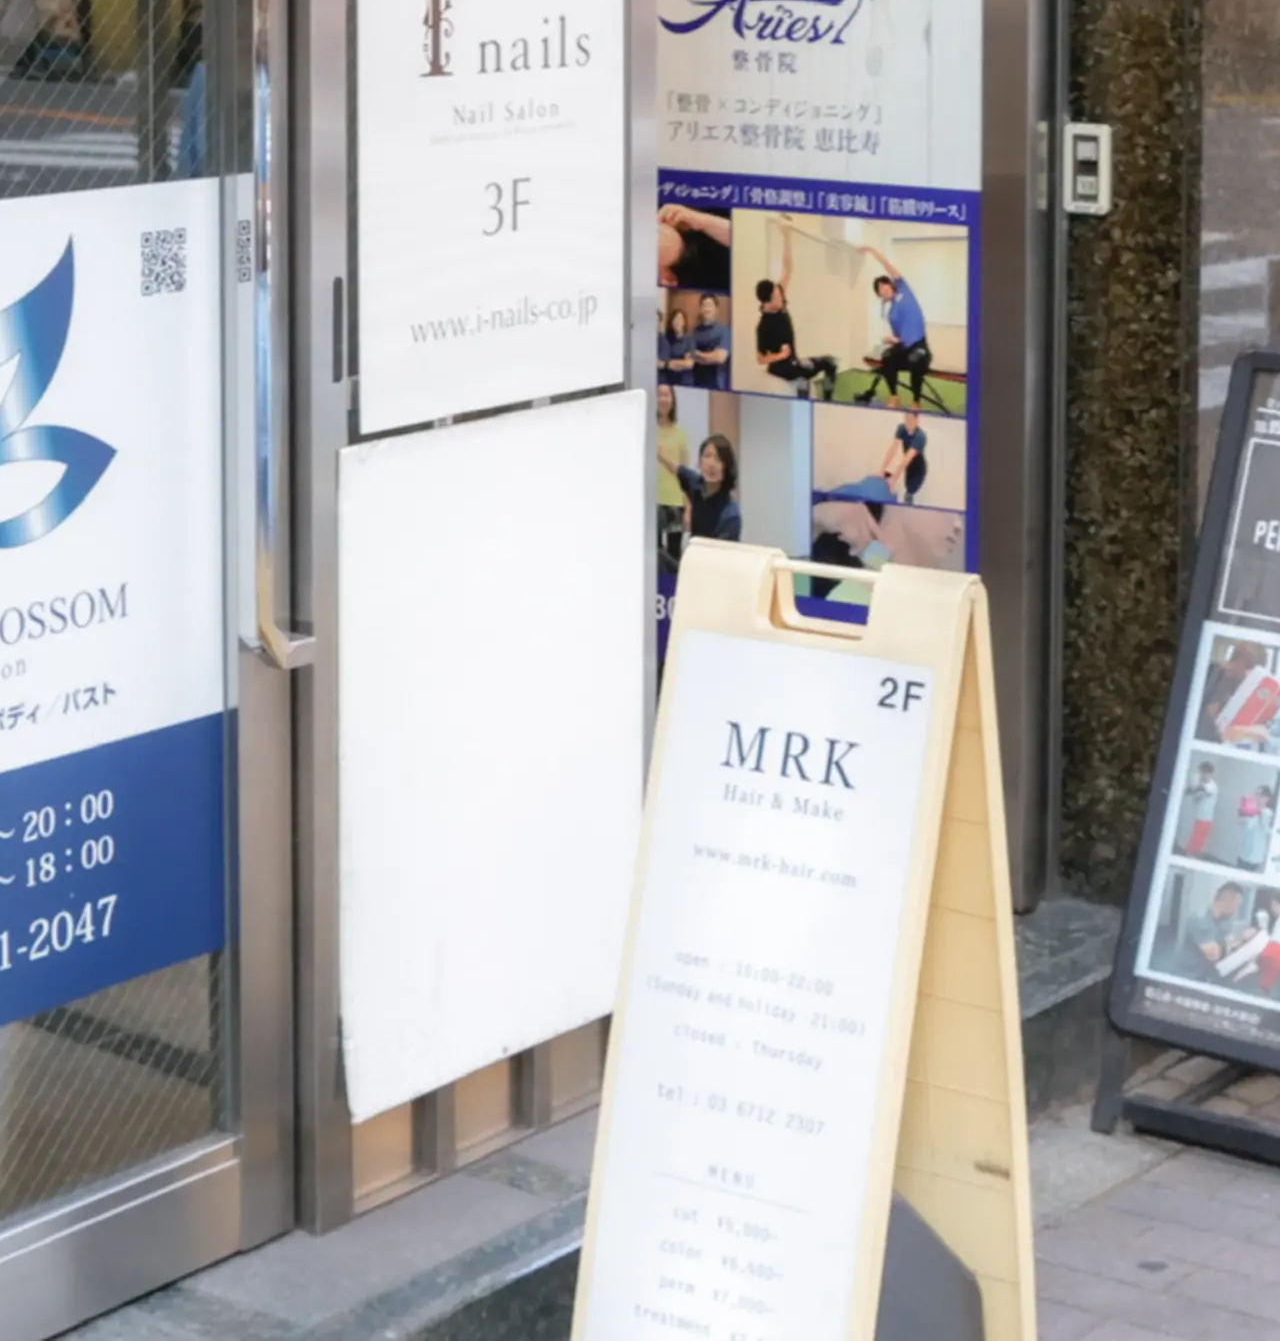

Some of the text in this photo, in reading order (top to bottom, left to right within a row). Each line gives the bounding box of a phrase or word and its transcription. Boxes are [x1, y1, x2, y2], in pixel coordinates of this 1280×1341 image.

[477, 15, 592, 75] nails
[732, 48, 798, 75] 整骨院
[452, 97, 561, 127] Nail Salon
[667, 119, 882, 156] アリエス整骨院 恵比寿
[481, 176, 532, 237] 3F
[876, 676, 927, 713] 2F
[719, 720, 862, 791] MRK
[721, 782, 845, 823] Hair & Make
[692, 842, 859, 890] www.mrk-hair.com
[656, 1080, 684, 1104] tel
